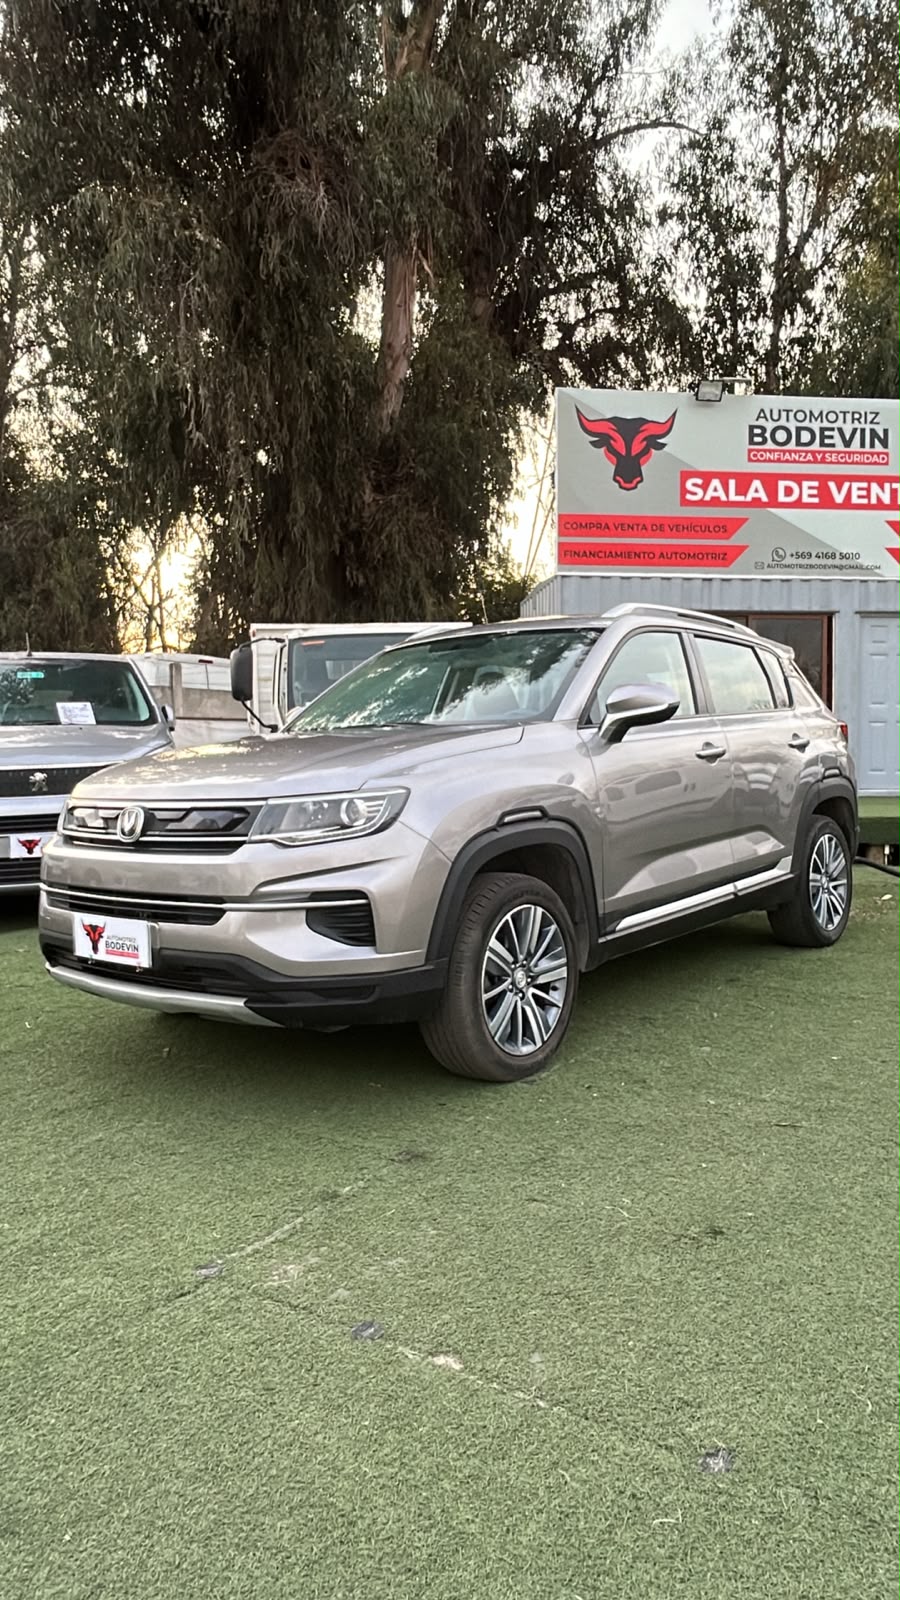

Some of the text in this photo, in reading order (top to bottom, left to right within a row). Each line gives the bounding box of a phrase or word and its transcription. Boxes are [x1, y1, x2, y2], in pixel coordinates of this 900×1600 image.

[755, 408, 880, 424] AUTOMOTRIZ
[748, 425, 889, 449] BODEVIN
[750, 451, 888, 464] CONFIANZA Y SEGURIDAD
[684, 478, 768, 502] SALA
[777, 480, 819, 503] DE
[564, 521, 728, 534] COMPRA VENTA DE VEHÍCULOS
[563, 550, 728, 562] FINANCIAMIENTO AUTOMOTRIZ
[789, 551, 861, 560] +569 4168 5010
[105, 941, 139, 952] BODEVIN
